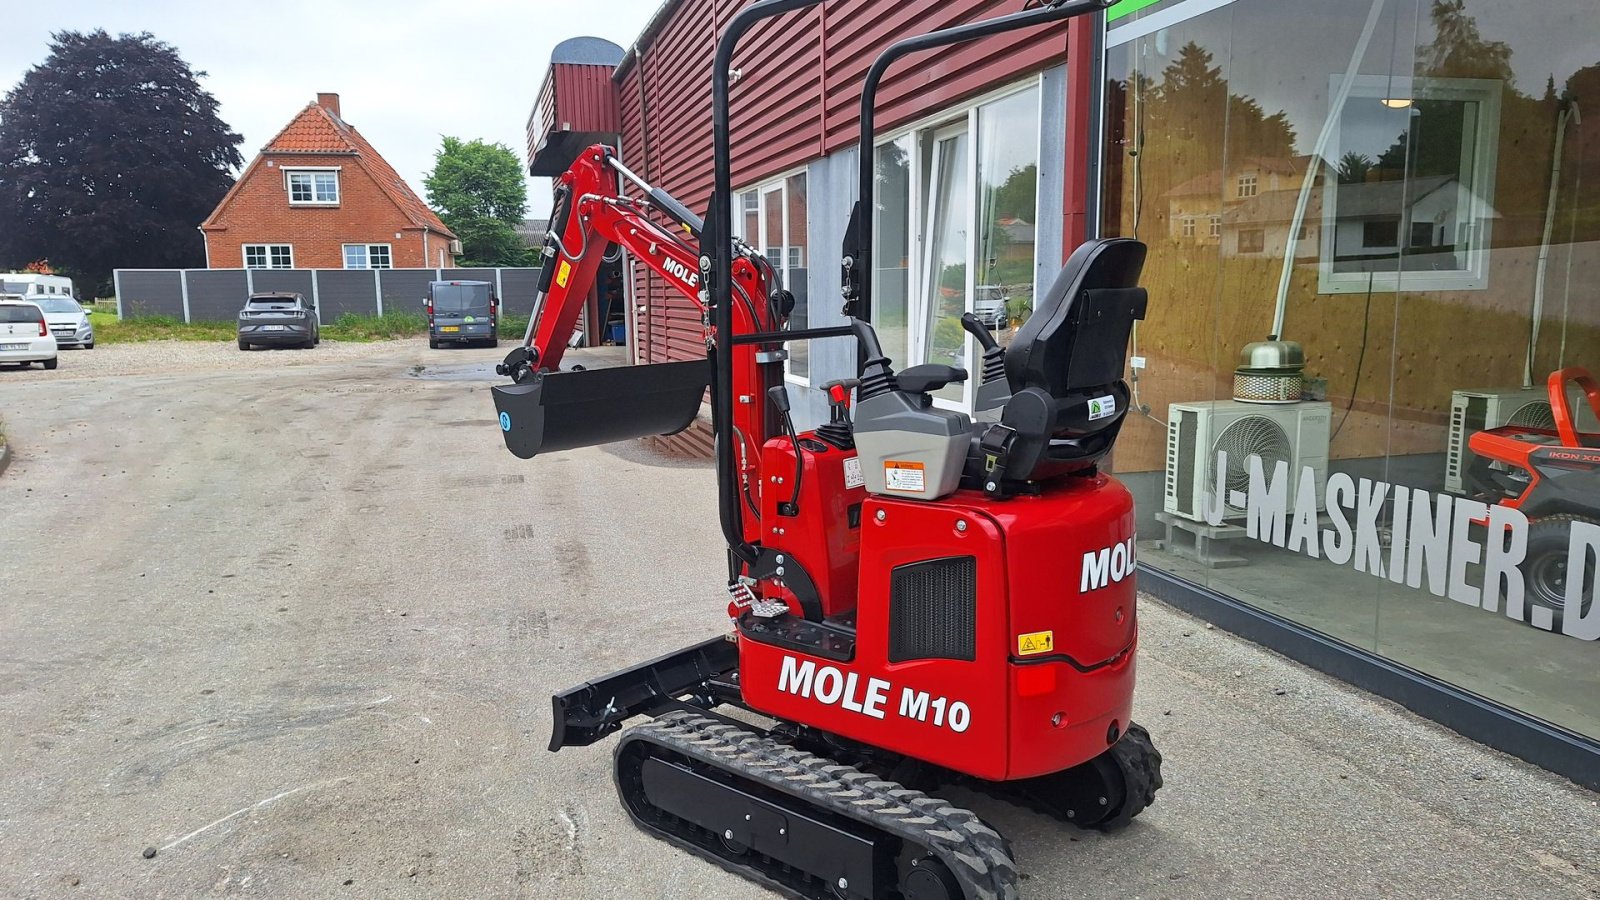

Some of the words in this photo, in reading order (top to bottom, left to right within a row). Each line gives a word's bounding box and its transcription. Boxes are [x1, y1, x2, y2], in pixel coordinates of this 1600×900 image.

[661, 256, 700, 288] MOLE
[1549, 452, 1580, 460] IKON
[777, 655, 891, 719] MOLE
[899, 687, 971, 732] M10
